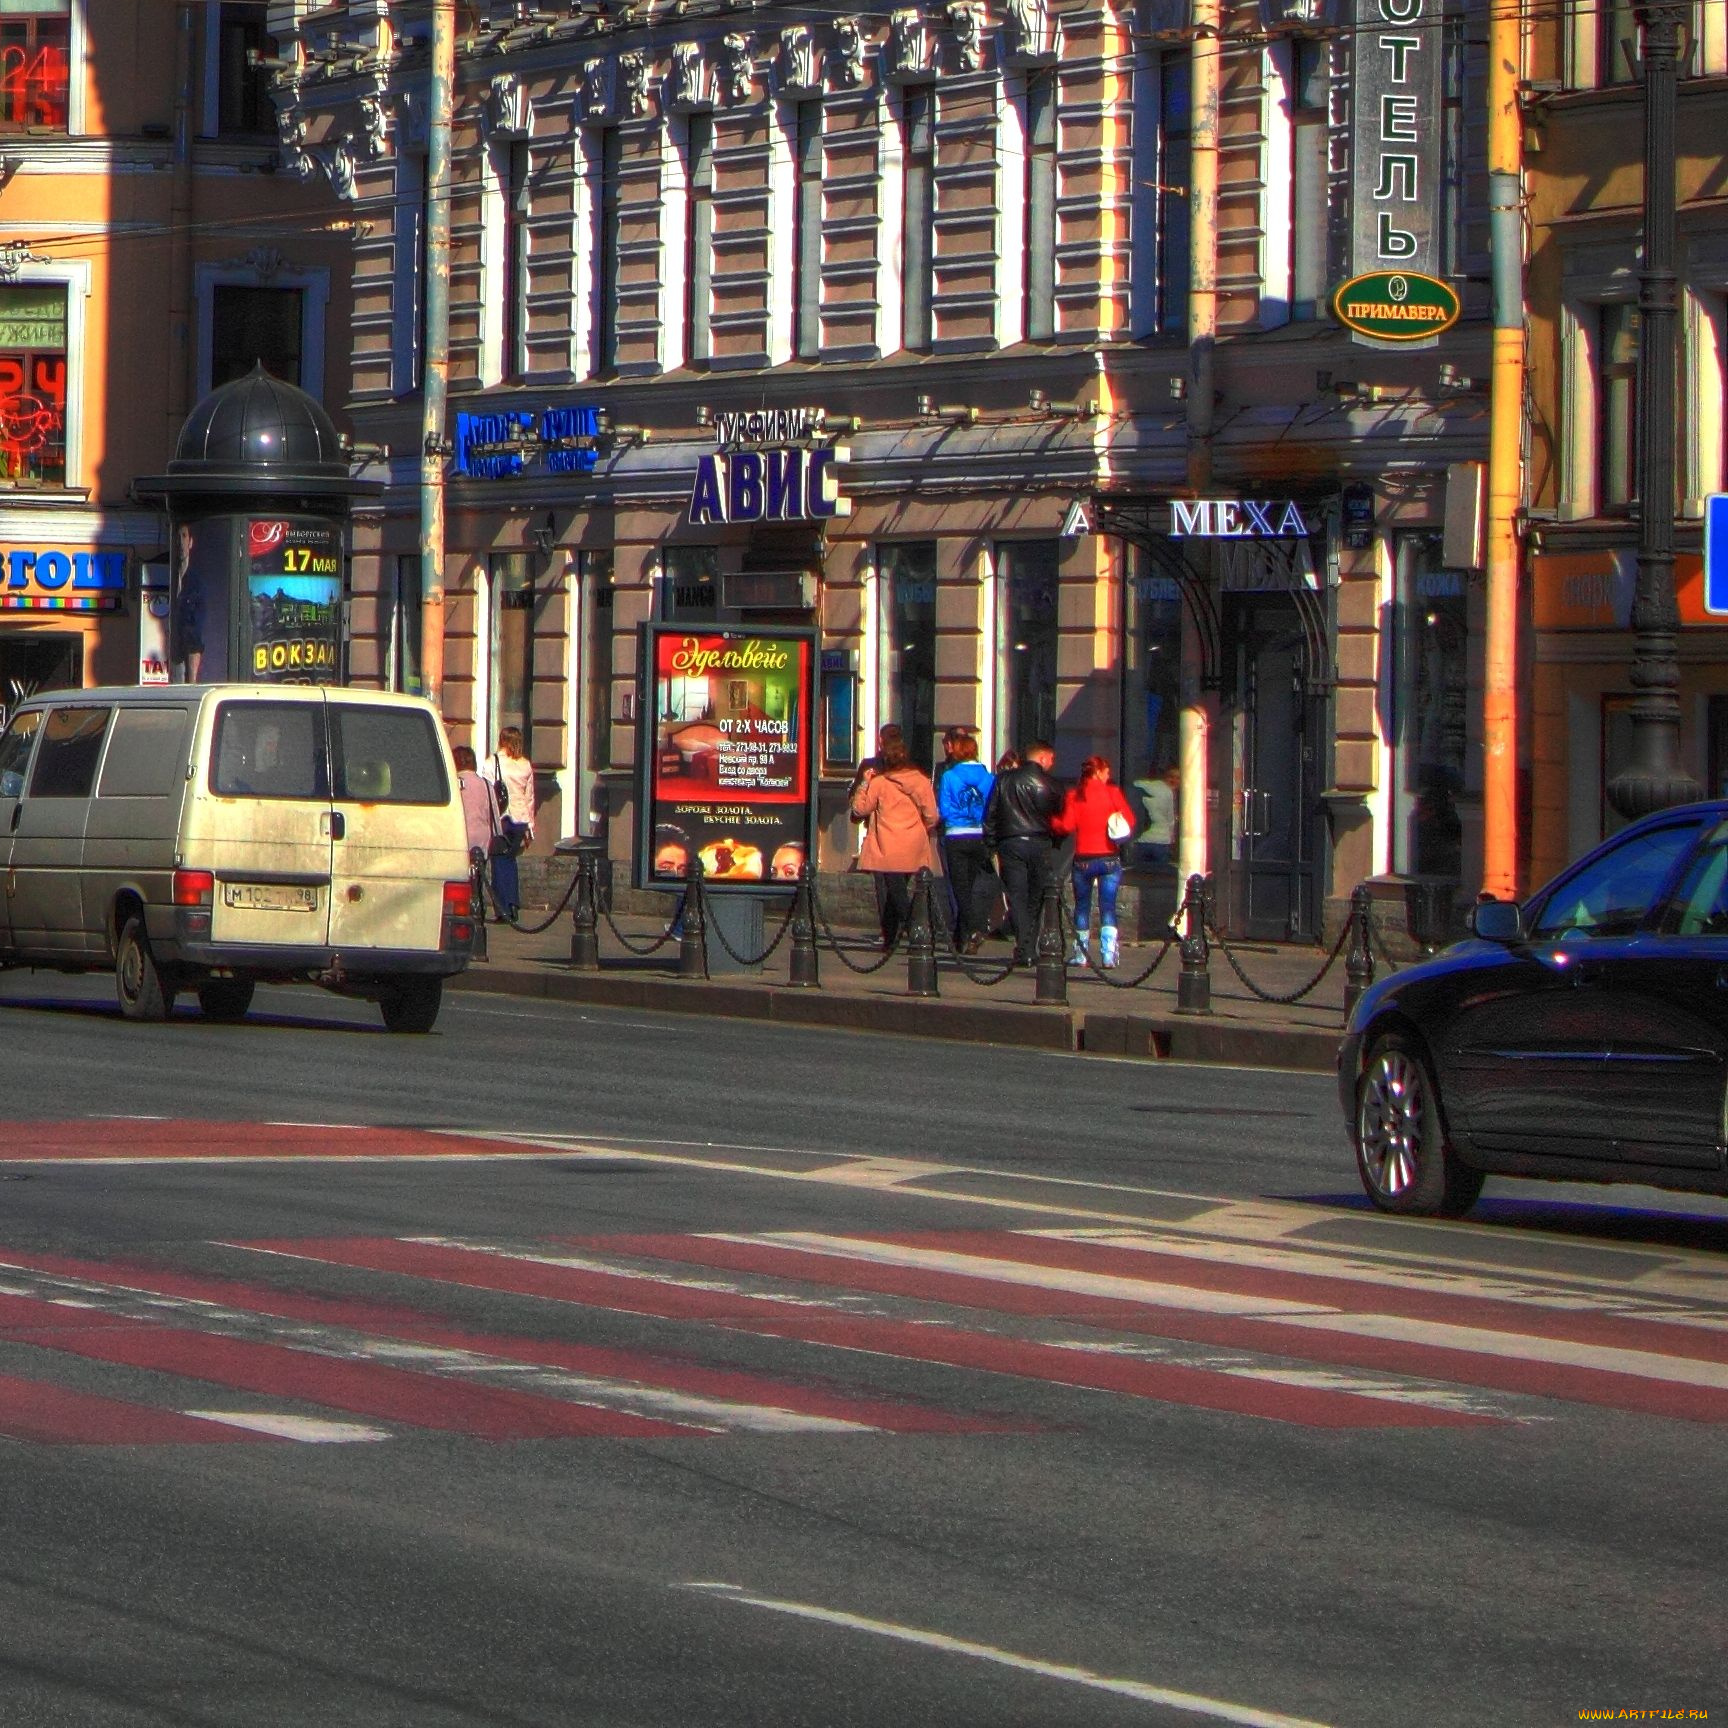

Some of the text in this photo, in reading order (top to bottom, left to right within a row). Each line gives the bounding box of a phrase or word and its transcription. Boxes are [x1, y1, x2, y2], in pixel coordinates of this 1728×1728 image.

[1347, 304, 1447, 321] ПРИМАВЕРА
[689, 446, 850, 524] АВИС
[1169, 500, 1308, 536] МЕХА
[9, 552, 126, 588] ГОШ
[284, 549, 337, 572] 17 МАЯ
[256, 643, 335, 669] ВОКЗАЛ
[672, 637, 788, 678] Эдельвейс
[719, 719, 733, 732] ОТ
[754, 719, 789, 734] ЧАСОВ
